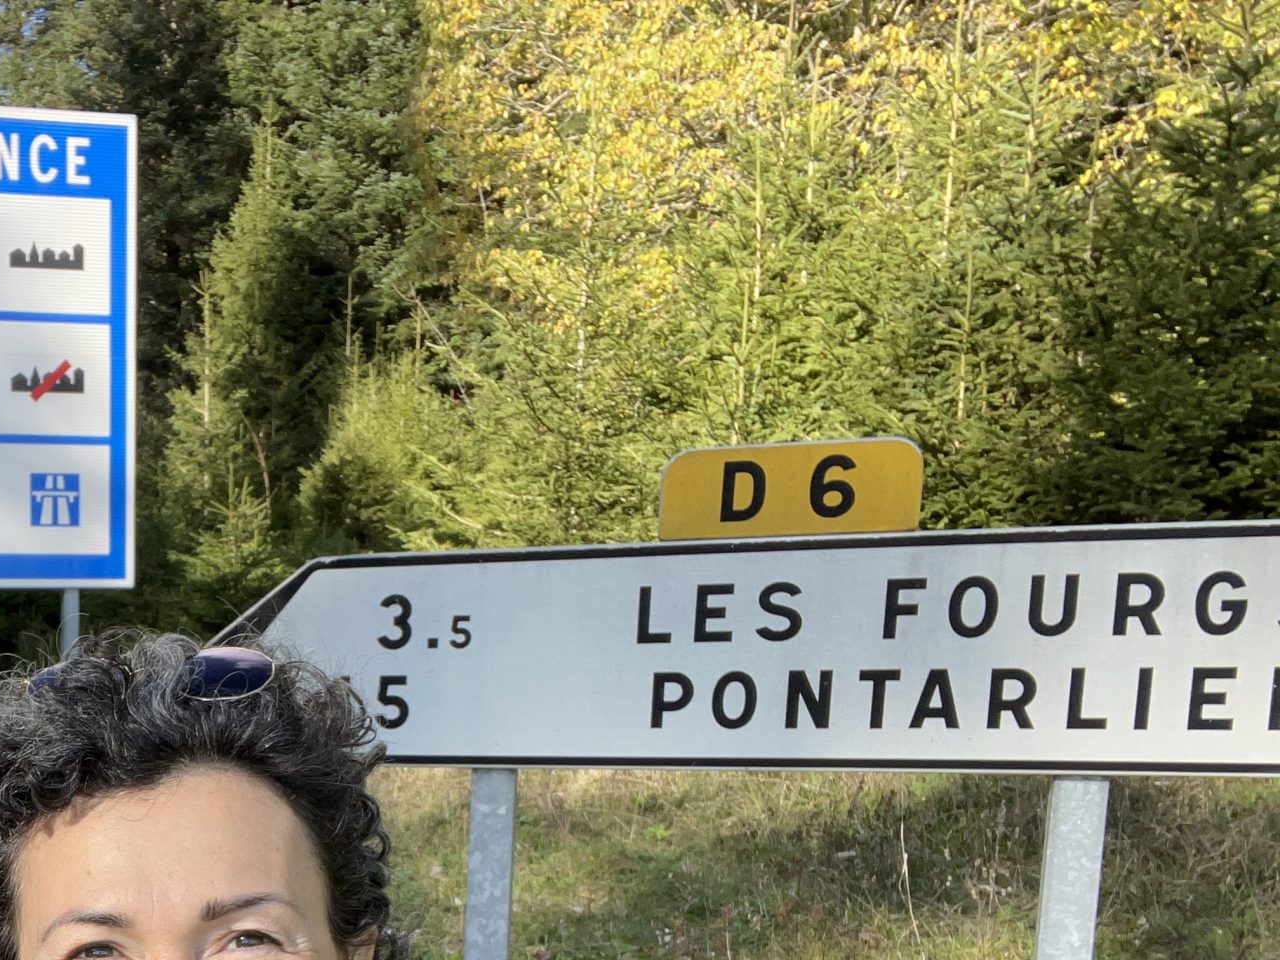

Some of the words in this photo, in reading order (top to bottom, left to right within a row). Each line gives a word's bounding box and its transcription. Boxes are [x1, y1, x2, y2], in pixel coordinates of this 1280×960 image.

[720, 461, 765, 522] D
[810, 455, 856, 518] 6
[378, 595, 471, 649] 3.5
[637, 582, 802, 643] LES
[883, 571, 1280, 639] FOURG
[651, 667, 1280, 731] PONTARLIE
